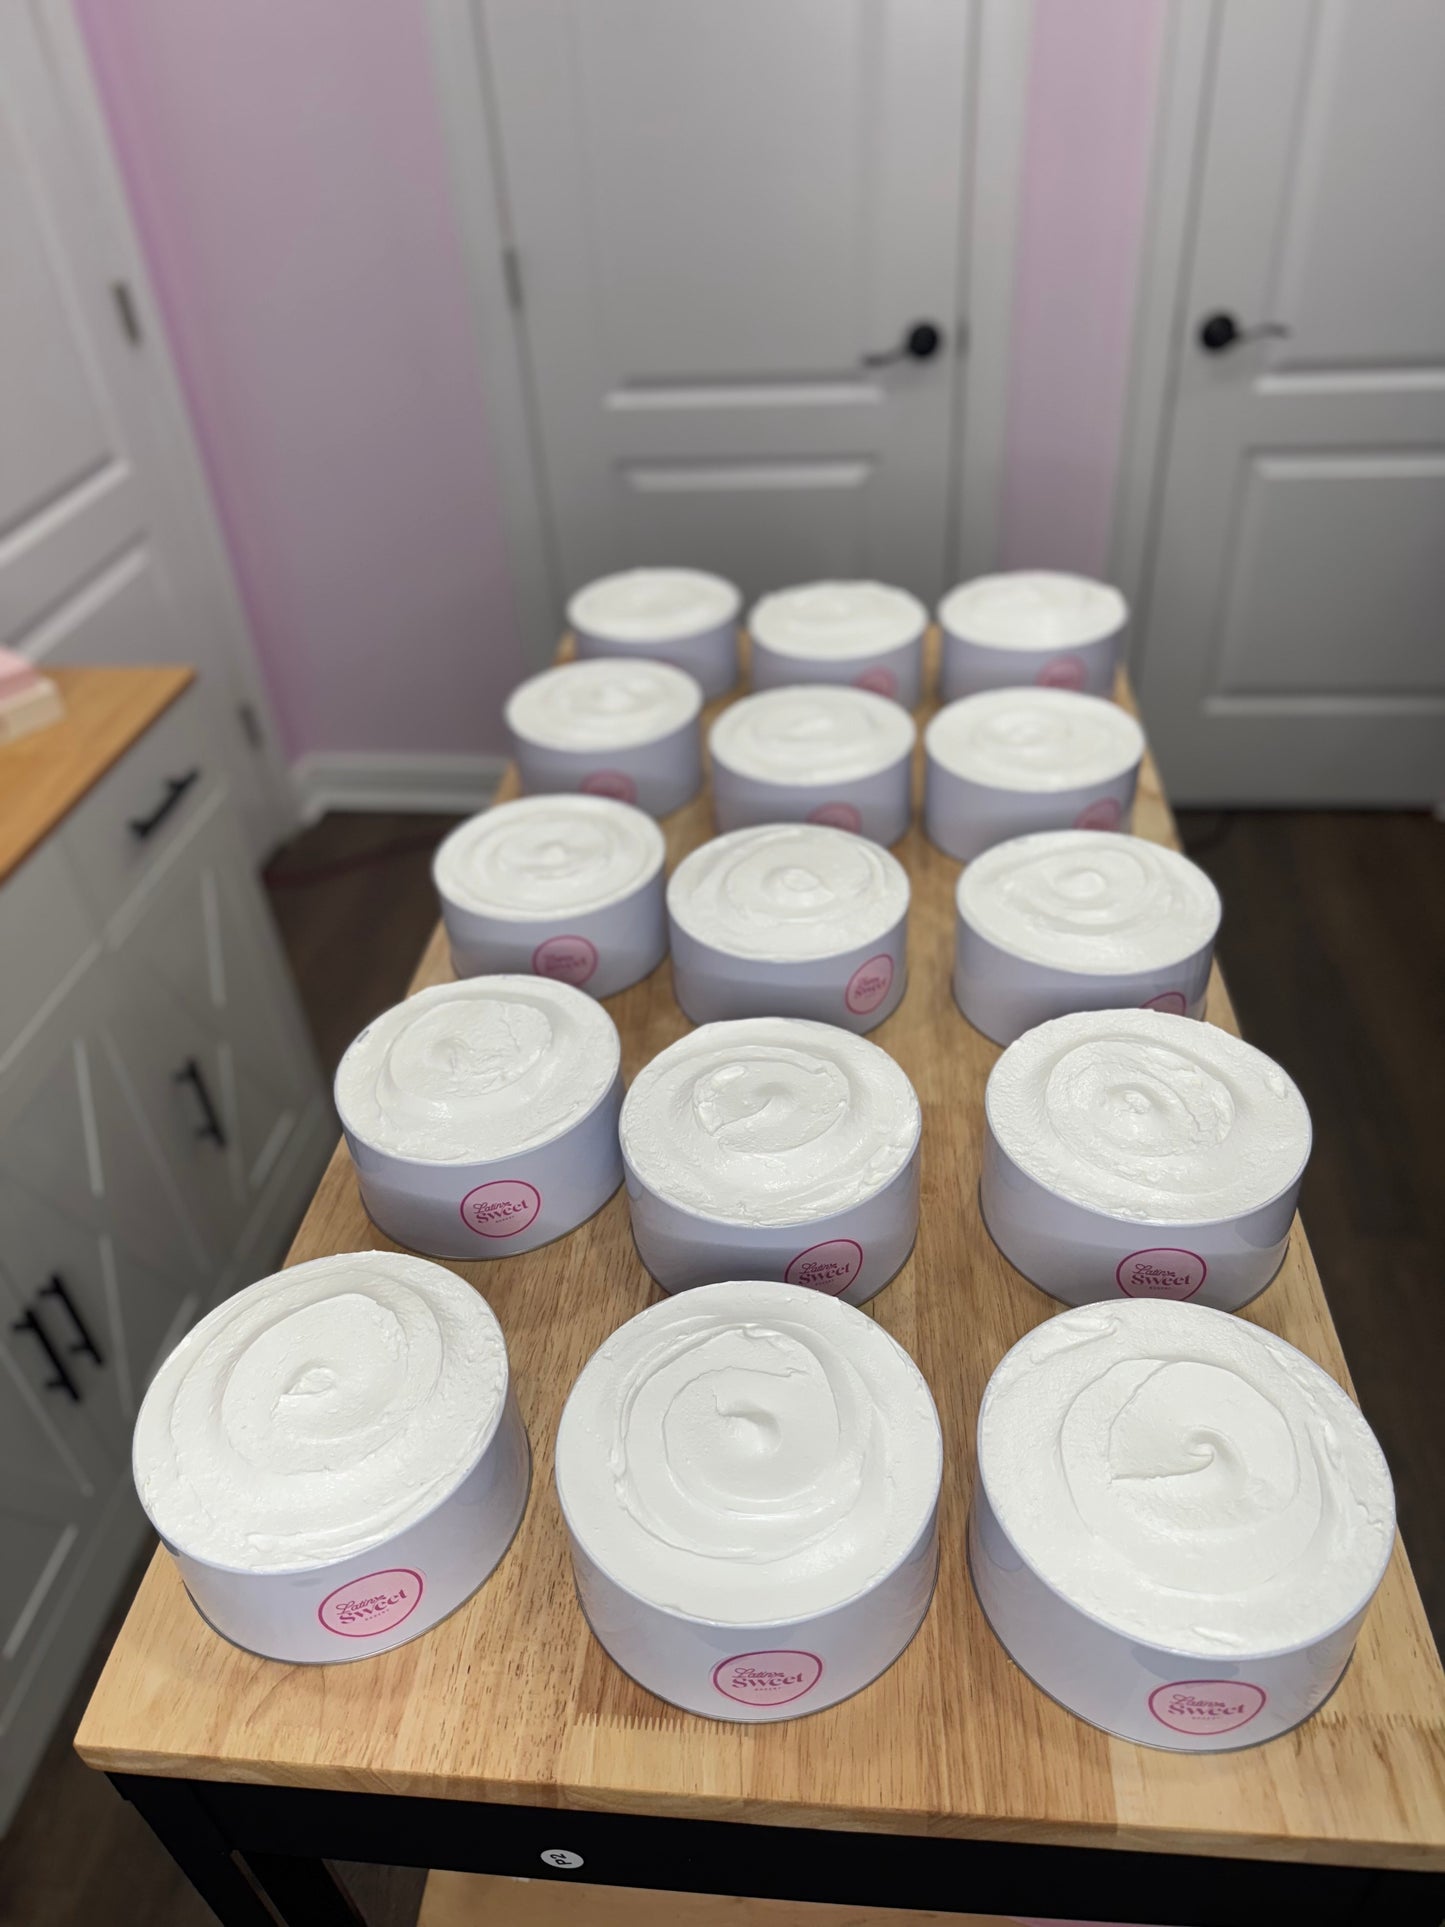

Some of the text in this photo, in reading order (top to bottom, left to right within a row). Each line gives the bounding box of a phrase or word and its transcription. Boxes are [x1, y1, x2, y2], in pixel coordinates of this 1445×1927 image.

[476, 1200, 528, 1223] Sweet
[1131, 1274, 1192, 1286] Sweet
[339, 1589, 407, 1624] Sweet
[732, 1672, 803, 1688] Sweet
[550, 1853, 572, 1865] P2
